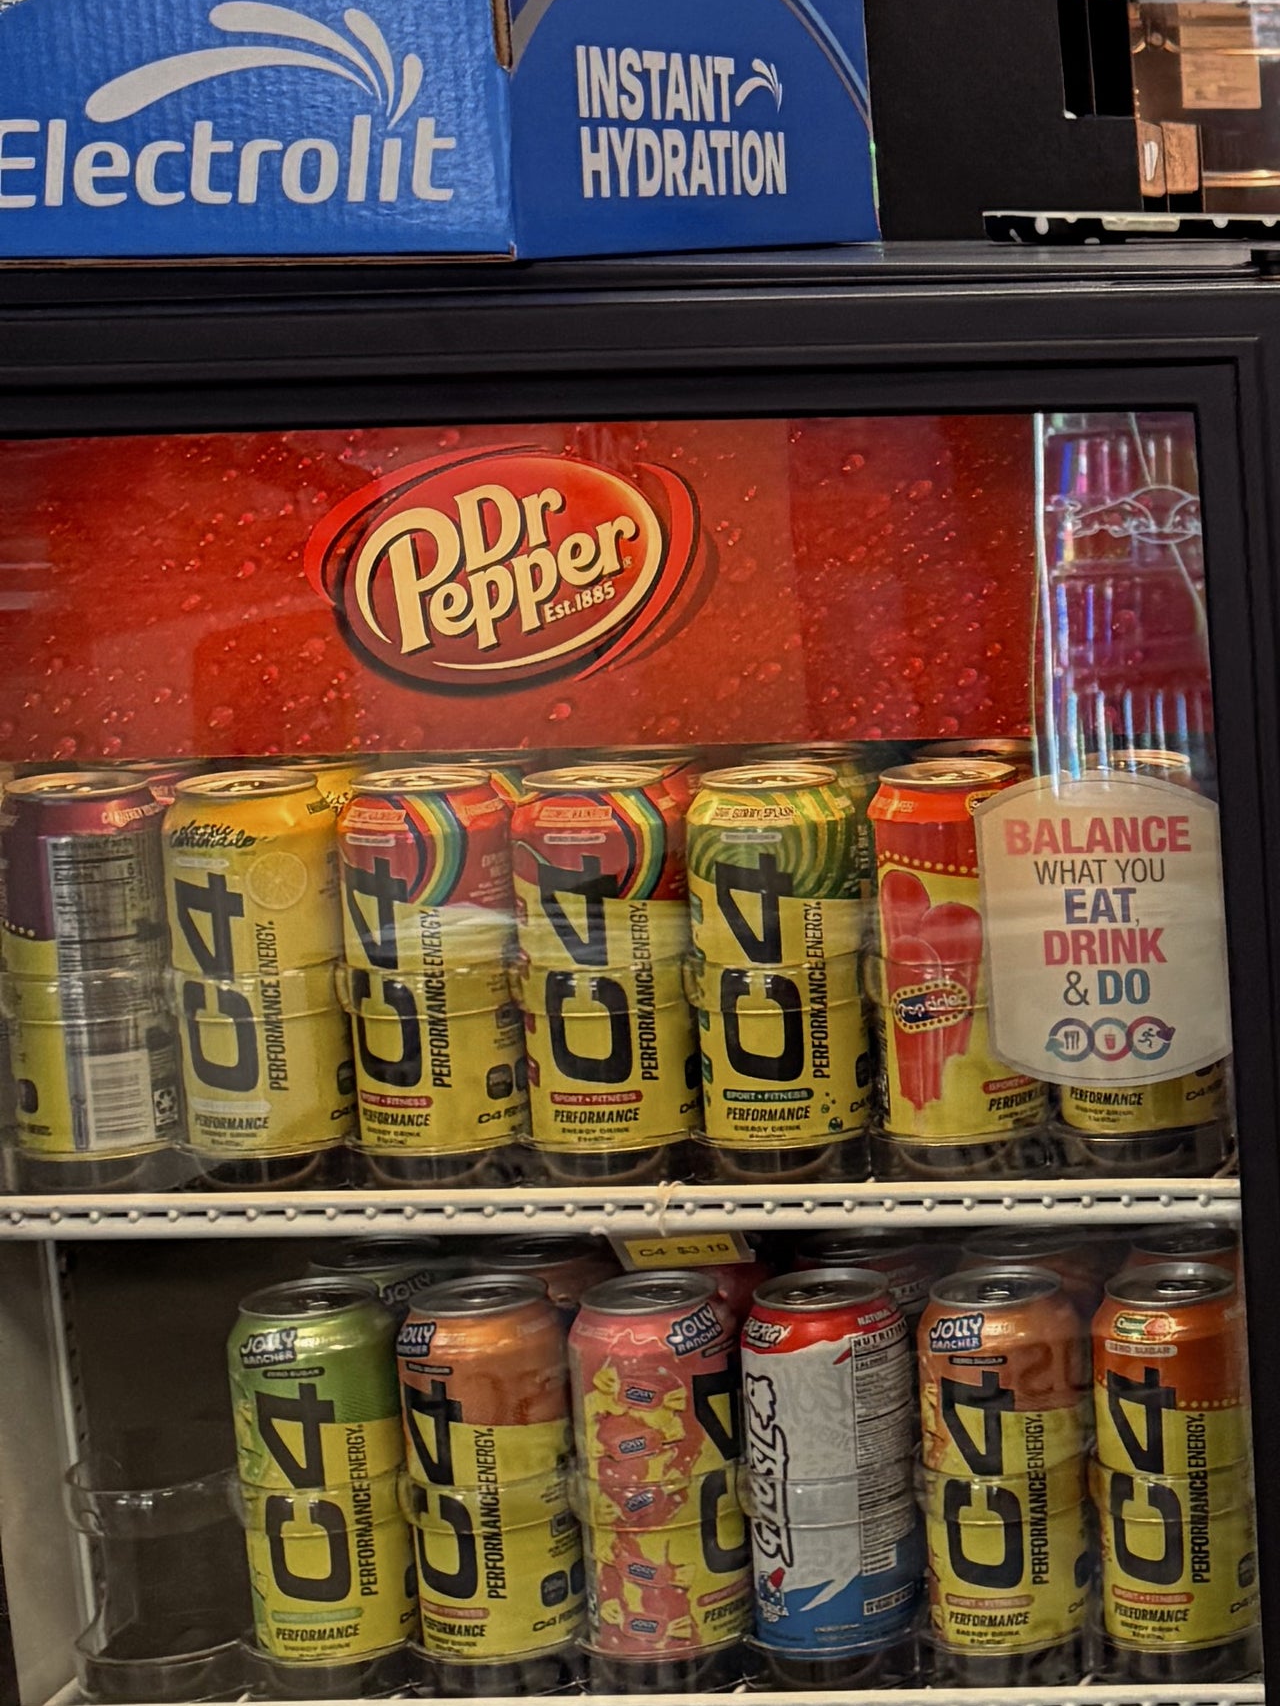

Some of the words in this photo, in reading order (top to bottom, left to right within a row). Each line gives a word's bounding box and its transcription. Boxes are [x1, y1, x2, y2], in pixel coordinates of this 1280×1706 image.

[575, 45, 737, 123] INSTANT
[0, 114, 457, 208] Electrolit
[580, 129, 788, 200] HYDRATION
[453, 484, 564, 571] Dr
[355, 506, 637, 654] Pepper
[1004, 815, 1191, 857] BALANCE
[1034, 860, 1112, 886] WHAT
[1118, 858, 1167, 884] YOU
[174, 872, 259, 1093] C4
[344, 855, 424, 1088] C4
[536, 854, 633, 1085] C4
[715, 852, 805, 1082] C4
[1043, 928, 1168, 966] DRINK
[1063, 970, 1092, 1007] &
[1098, 968, 1151, 1006] DO
[257, 979, 291, 1092] PERFORMANCE
[811, 965, 832, 1080] PERFORMANCE
[193, 1113, 271, 1131] PERFORMANCE
[554, 1106, 641, 1124] PERFORMANCE
[726, 1105, 811, 1122] PERFORMANCE
[1070, 1086, 1145, 1107] PERFORMANCE
[638, 1246, 669, 1259] C4
[241, 1326, 298, 1356] JOLLY
[670, 1304, 720, 1343] JOLLY
[929, 1313, 983, 1340] JOLLY
[254, 1381, 353, 1604] C4
[403, 1379, 480, 1600] C4
[940, 1371, 1025, 1589] C4
[1106, 1365, 1184, 1586] C4
[354, 1489, 380, 1598] PERFORMANCE
[482, 1488, 507, 1600] PERFORMANCE
[1025, 1471, 1050, 1586] PERFORMANCE
[1186, 1470, 1212, 1584] PERFORMANCE
[275, 1623, 361, 1641] PERFORMANCE
[949, 1610, 1031, 1627] PERFORMANCE
[1113, 1602, 1191, 1623] PERFORMANCE
